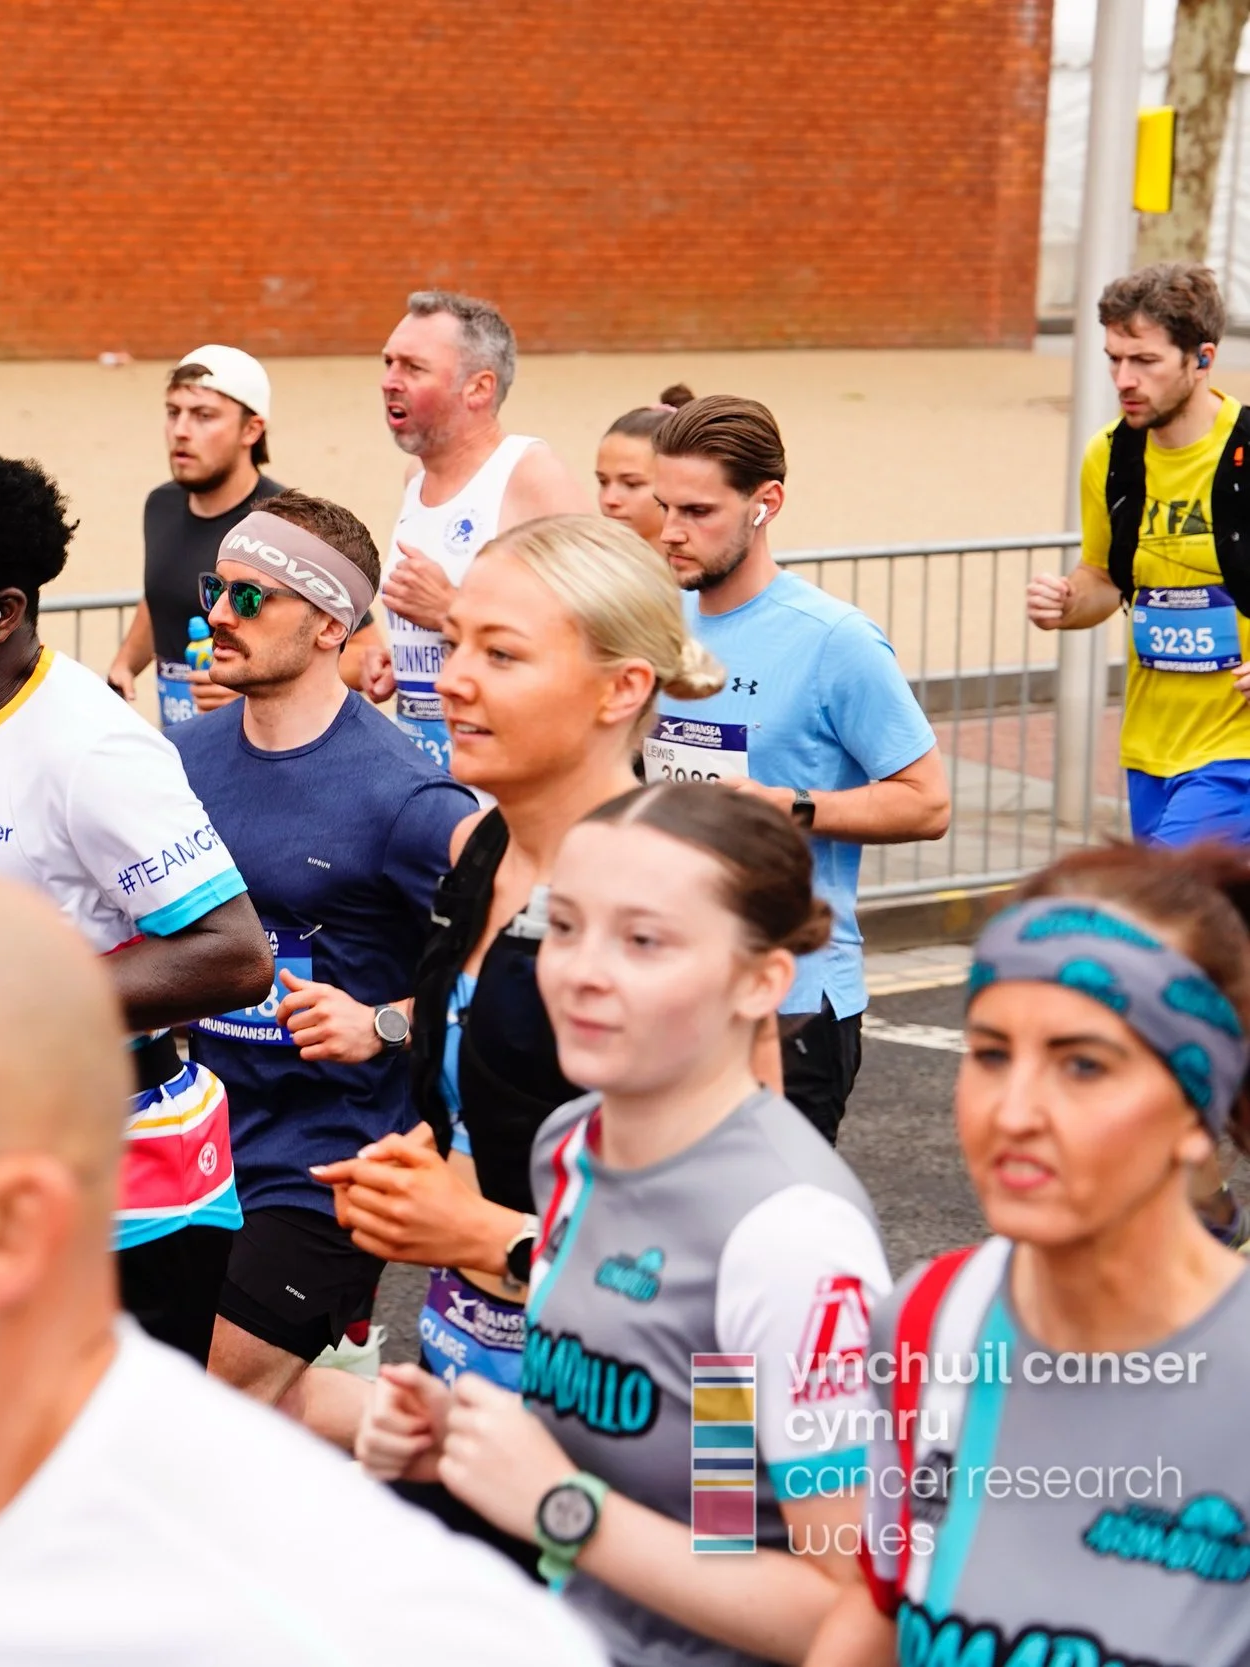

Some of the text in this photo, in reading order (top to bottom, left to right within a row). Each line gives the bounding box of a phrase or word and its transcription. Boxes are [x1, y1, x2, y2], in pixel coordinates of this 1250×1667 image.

[1150, 626, 1215, 655] 3235
[684, 721, 722, 737] SWANSEA
[645, 744, 676, 761] LEWIS
[307, 856, 331, 869] KIPRUN
[198, 1017, 283, 1041] #RUNSWANSEA
[285, 1284, 306, 1300] KIPRUN
[420, 1317, 468, 1368] CLAIRE
